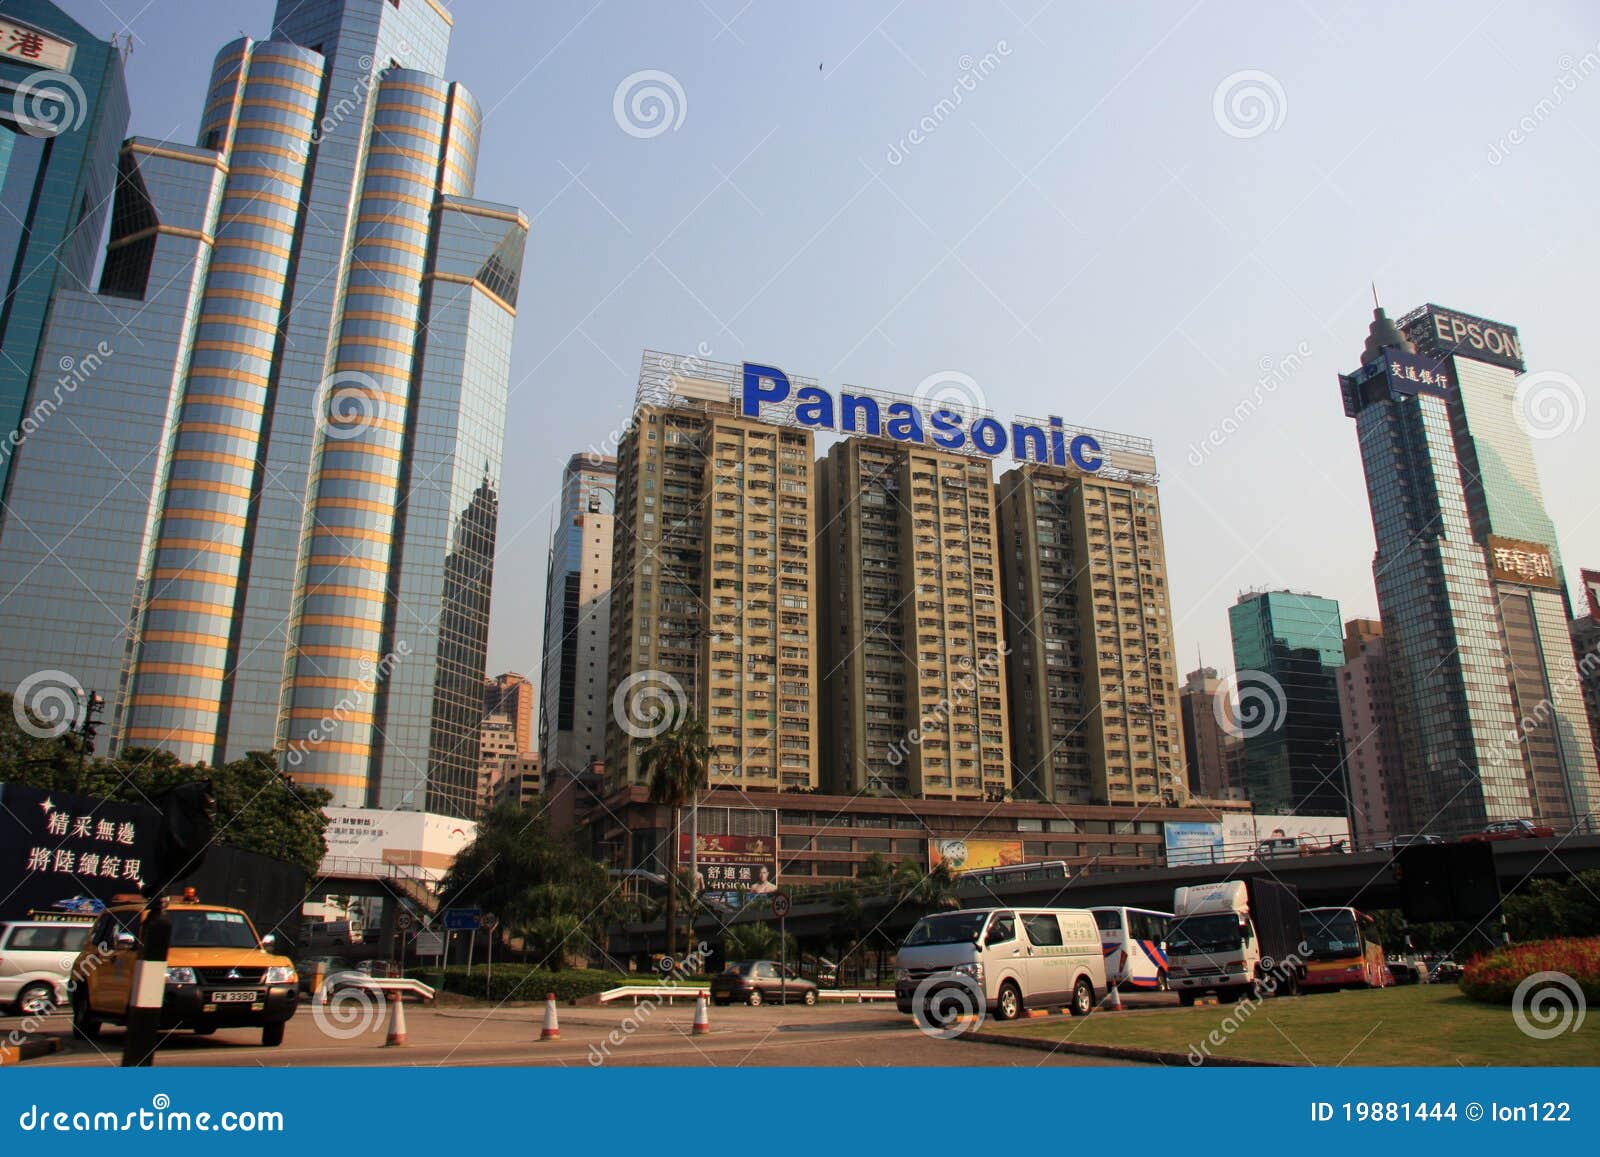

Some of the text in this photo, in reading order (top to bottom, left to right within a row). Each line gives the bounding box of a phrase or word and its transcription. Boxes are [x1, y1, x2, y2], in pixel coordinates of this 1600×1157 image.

[0, 29, 43, 58] 港
[1434, 314, 1523, 360] EPSON
[1390, 361, 1448, 389] 交通銀行
[742, 361, 1102, 473] Panasonic
[48, 811, 135, 845] 精采無邊
[26, 847, 141, 880] 將陸續綻現
[775, 900, 786, 910] 50
